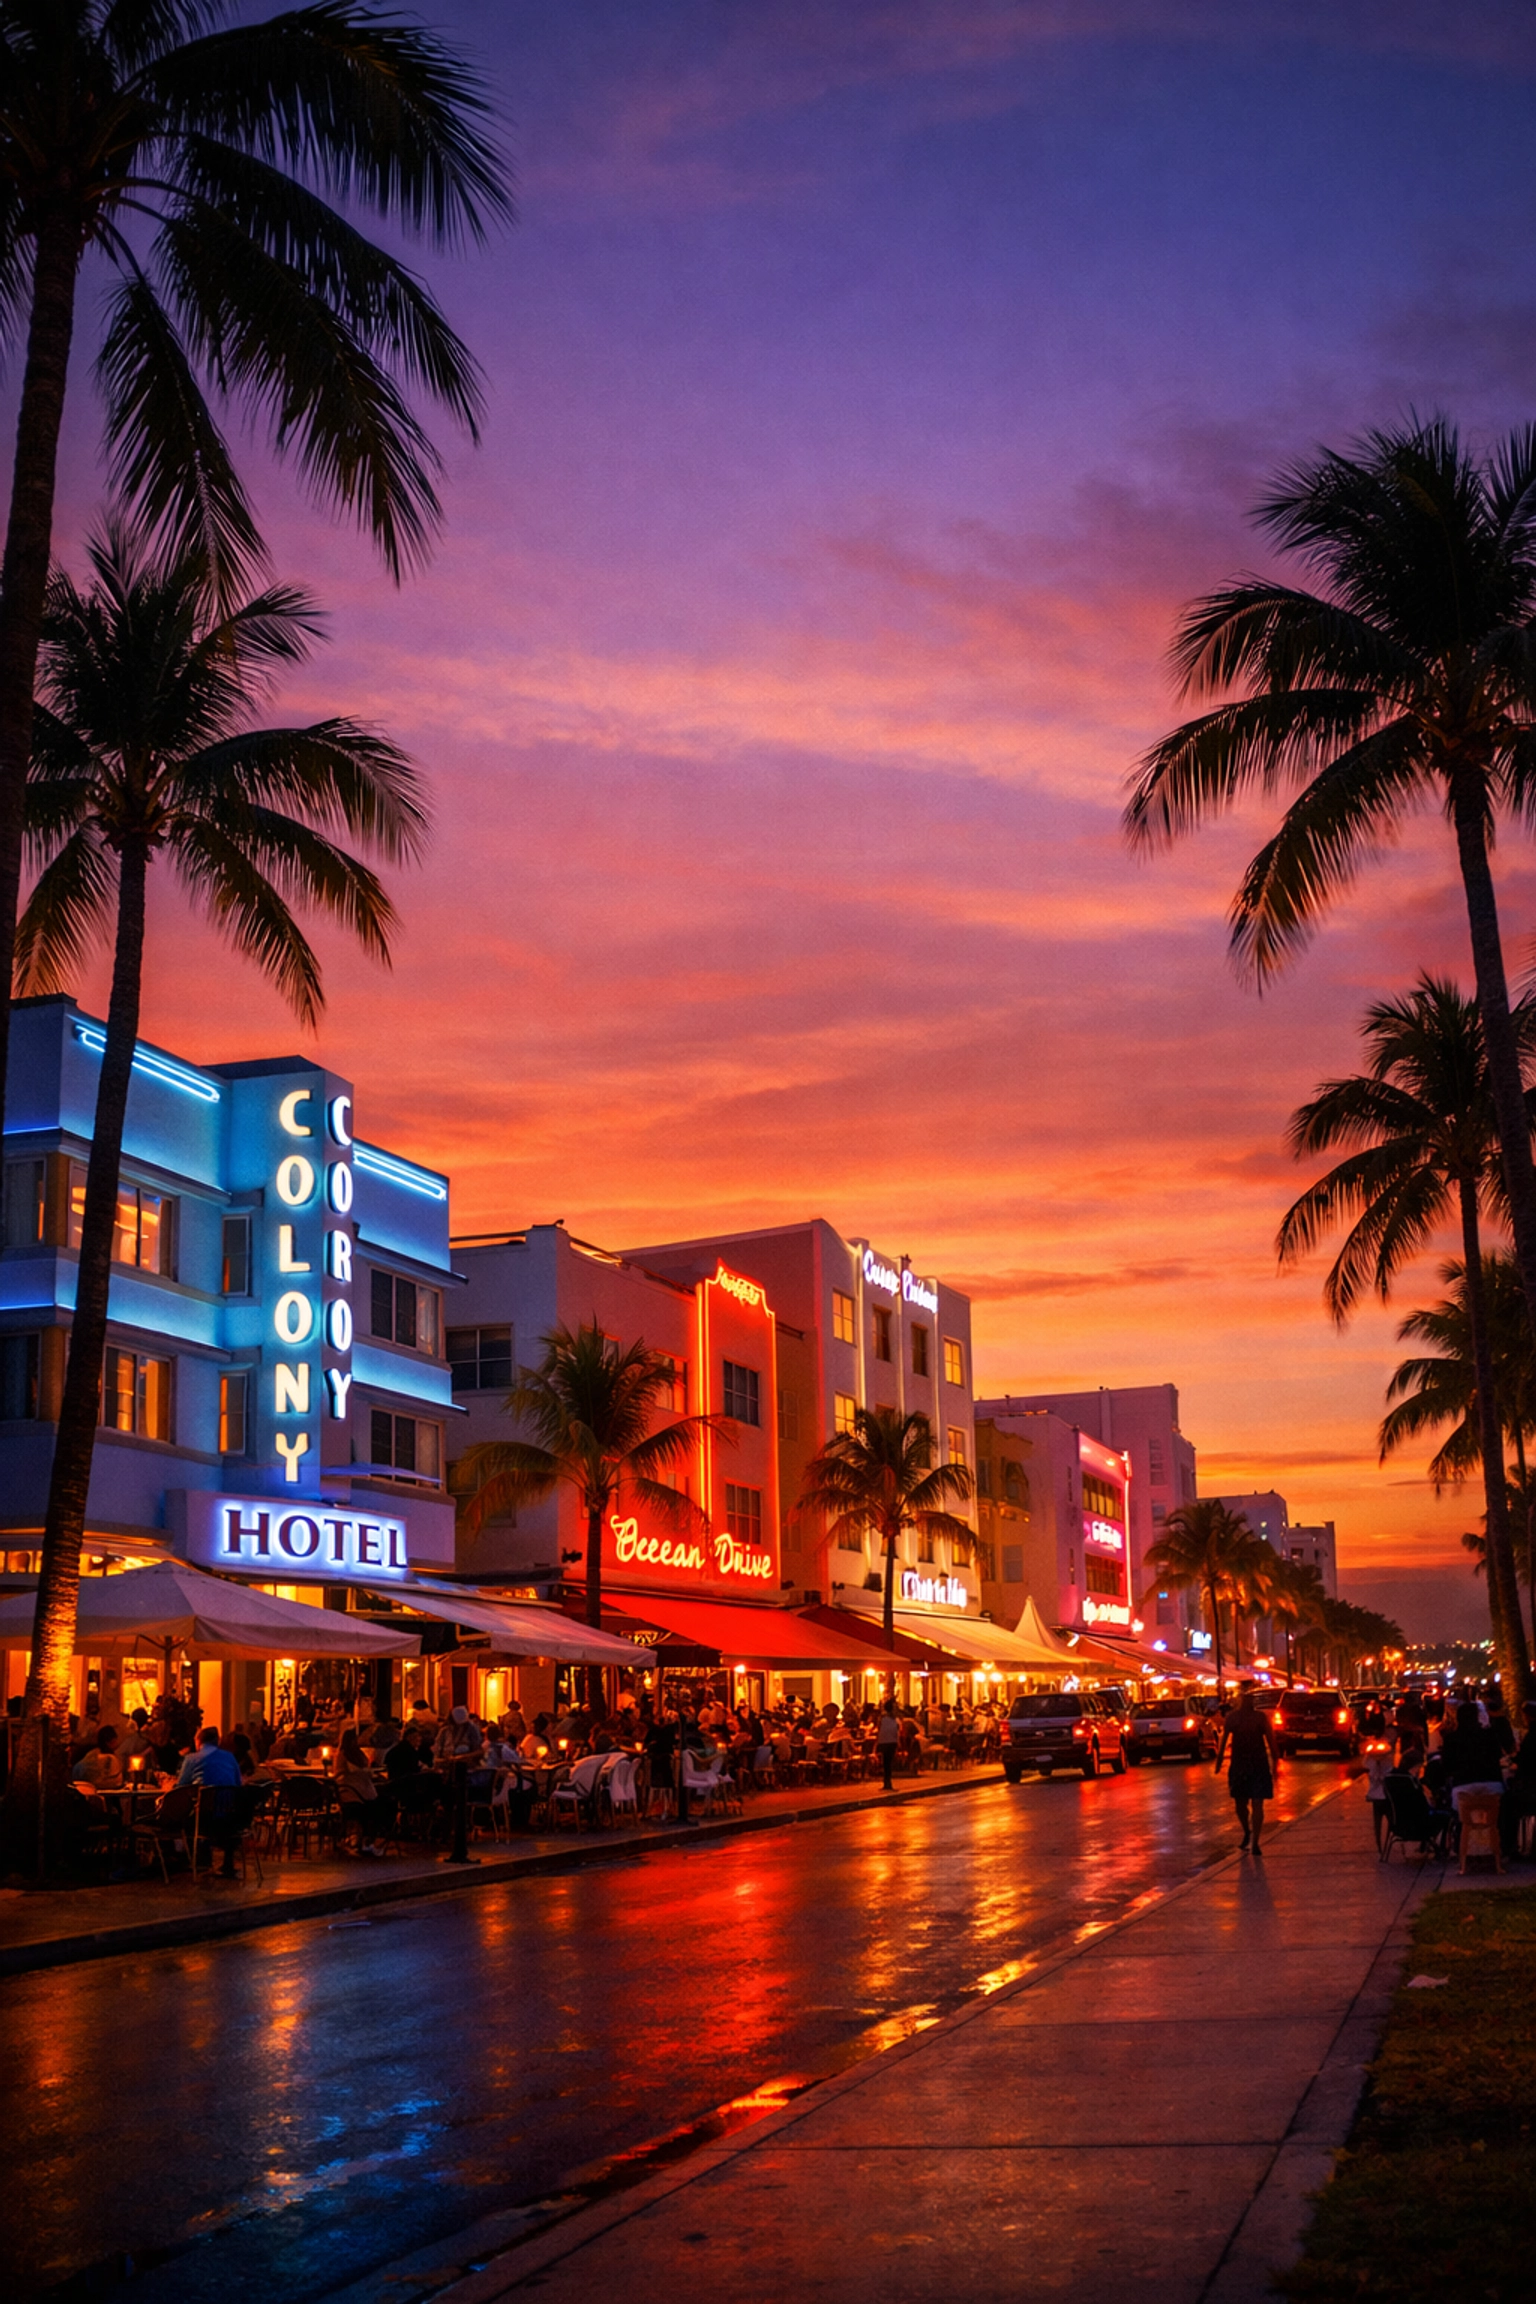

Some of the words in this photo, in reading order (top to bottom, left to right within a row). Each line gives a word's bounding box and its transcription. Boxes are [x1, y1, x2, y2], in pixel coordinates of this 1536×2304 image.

[274, 1089, 314, 1482] COLONY
[327, 1095, 353, 1420] COROY
[223, 1508, 408, 1569] HOTEL
